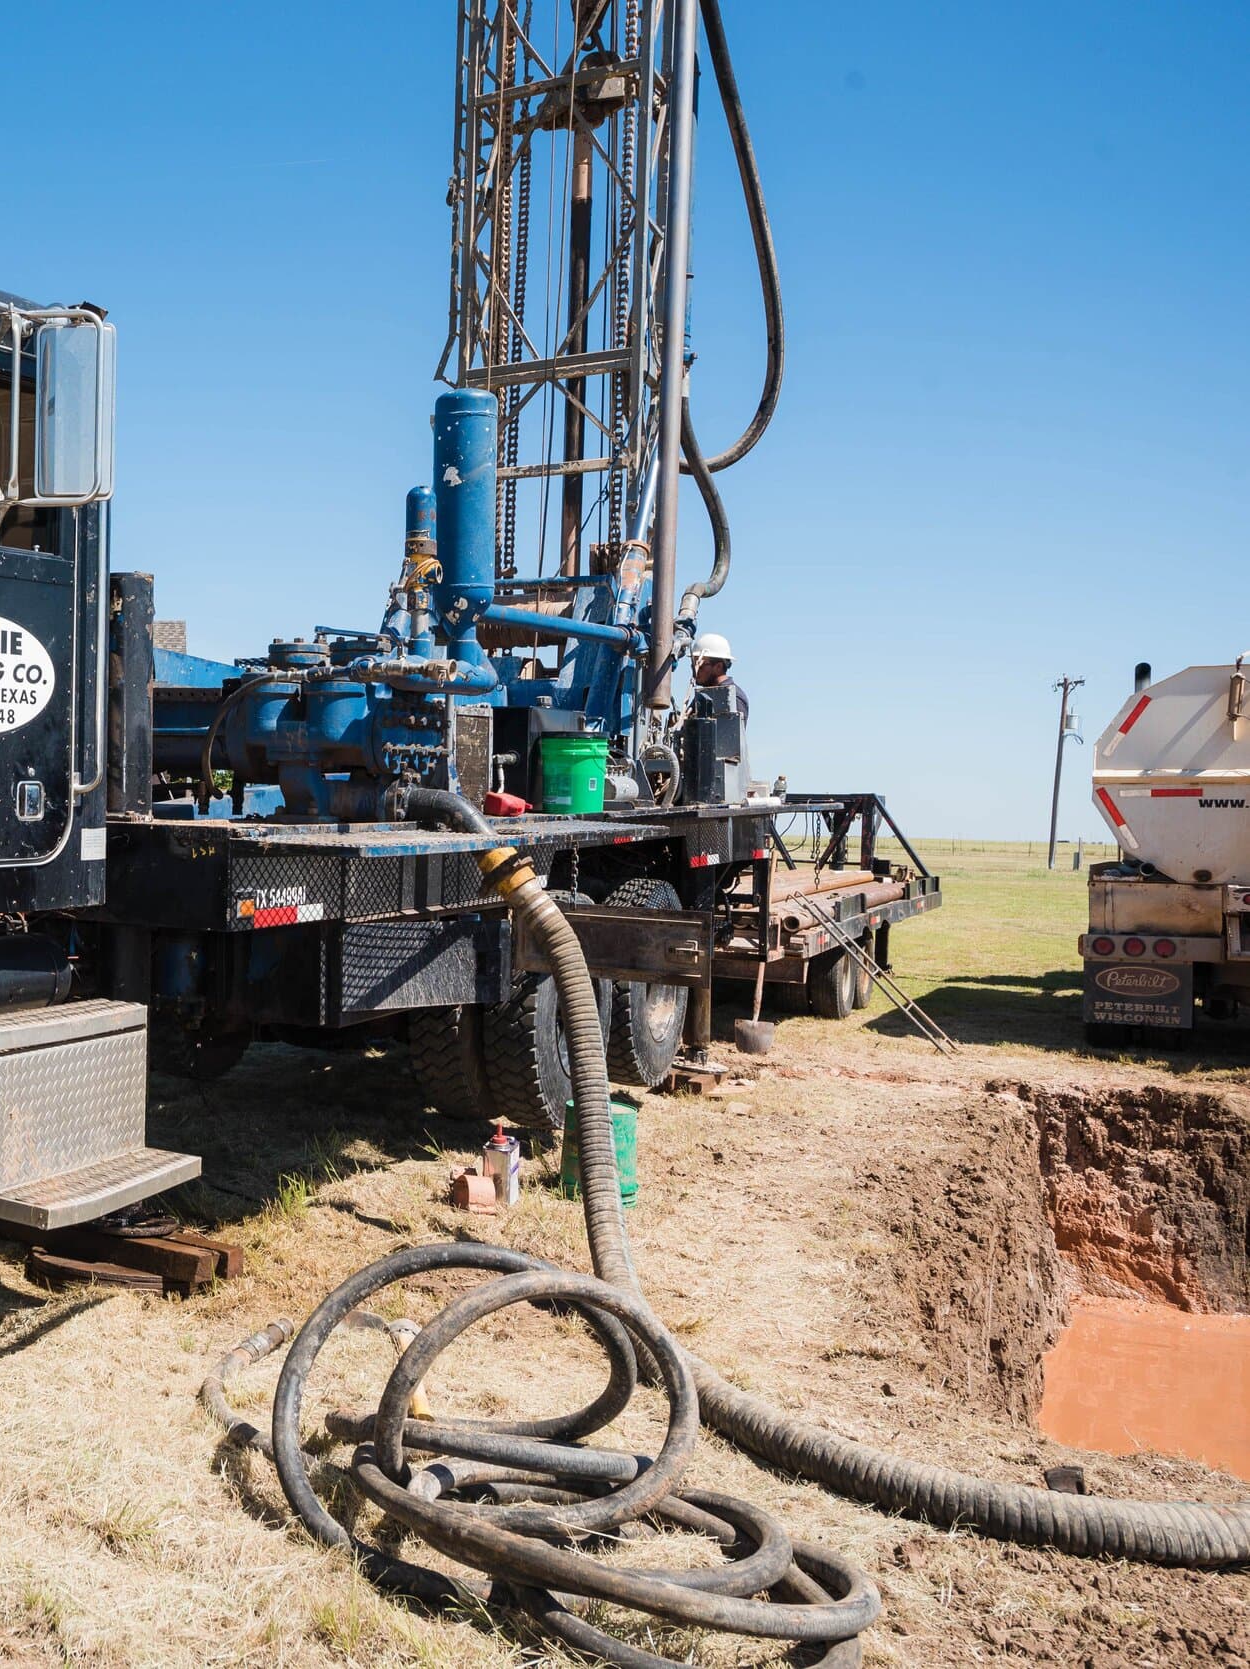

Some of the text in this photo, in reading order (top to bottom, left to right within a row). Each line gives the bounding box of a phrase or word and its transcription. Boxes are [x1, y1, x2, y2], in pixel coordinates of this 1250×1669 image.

[13, 664, 48, 685] CO.
[256, 888, 268, 909] TX
[1106, 971, 1171, 988] Peterbilt
[1093, 1001, 1182, 1014] PETERBILT
[1093, 1012, 1182, 1025] WISCONSIN
